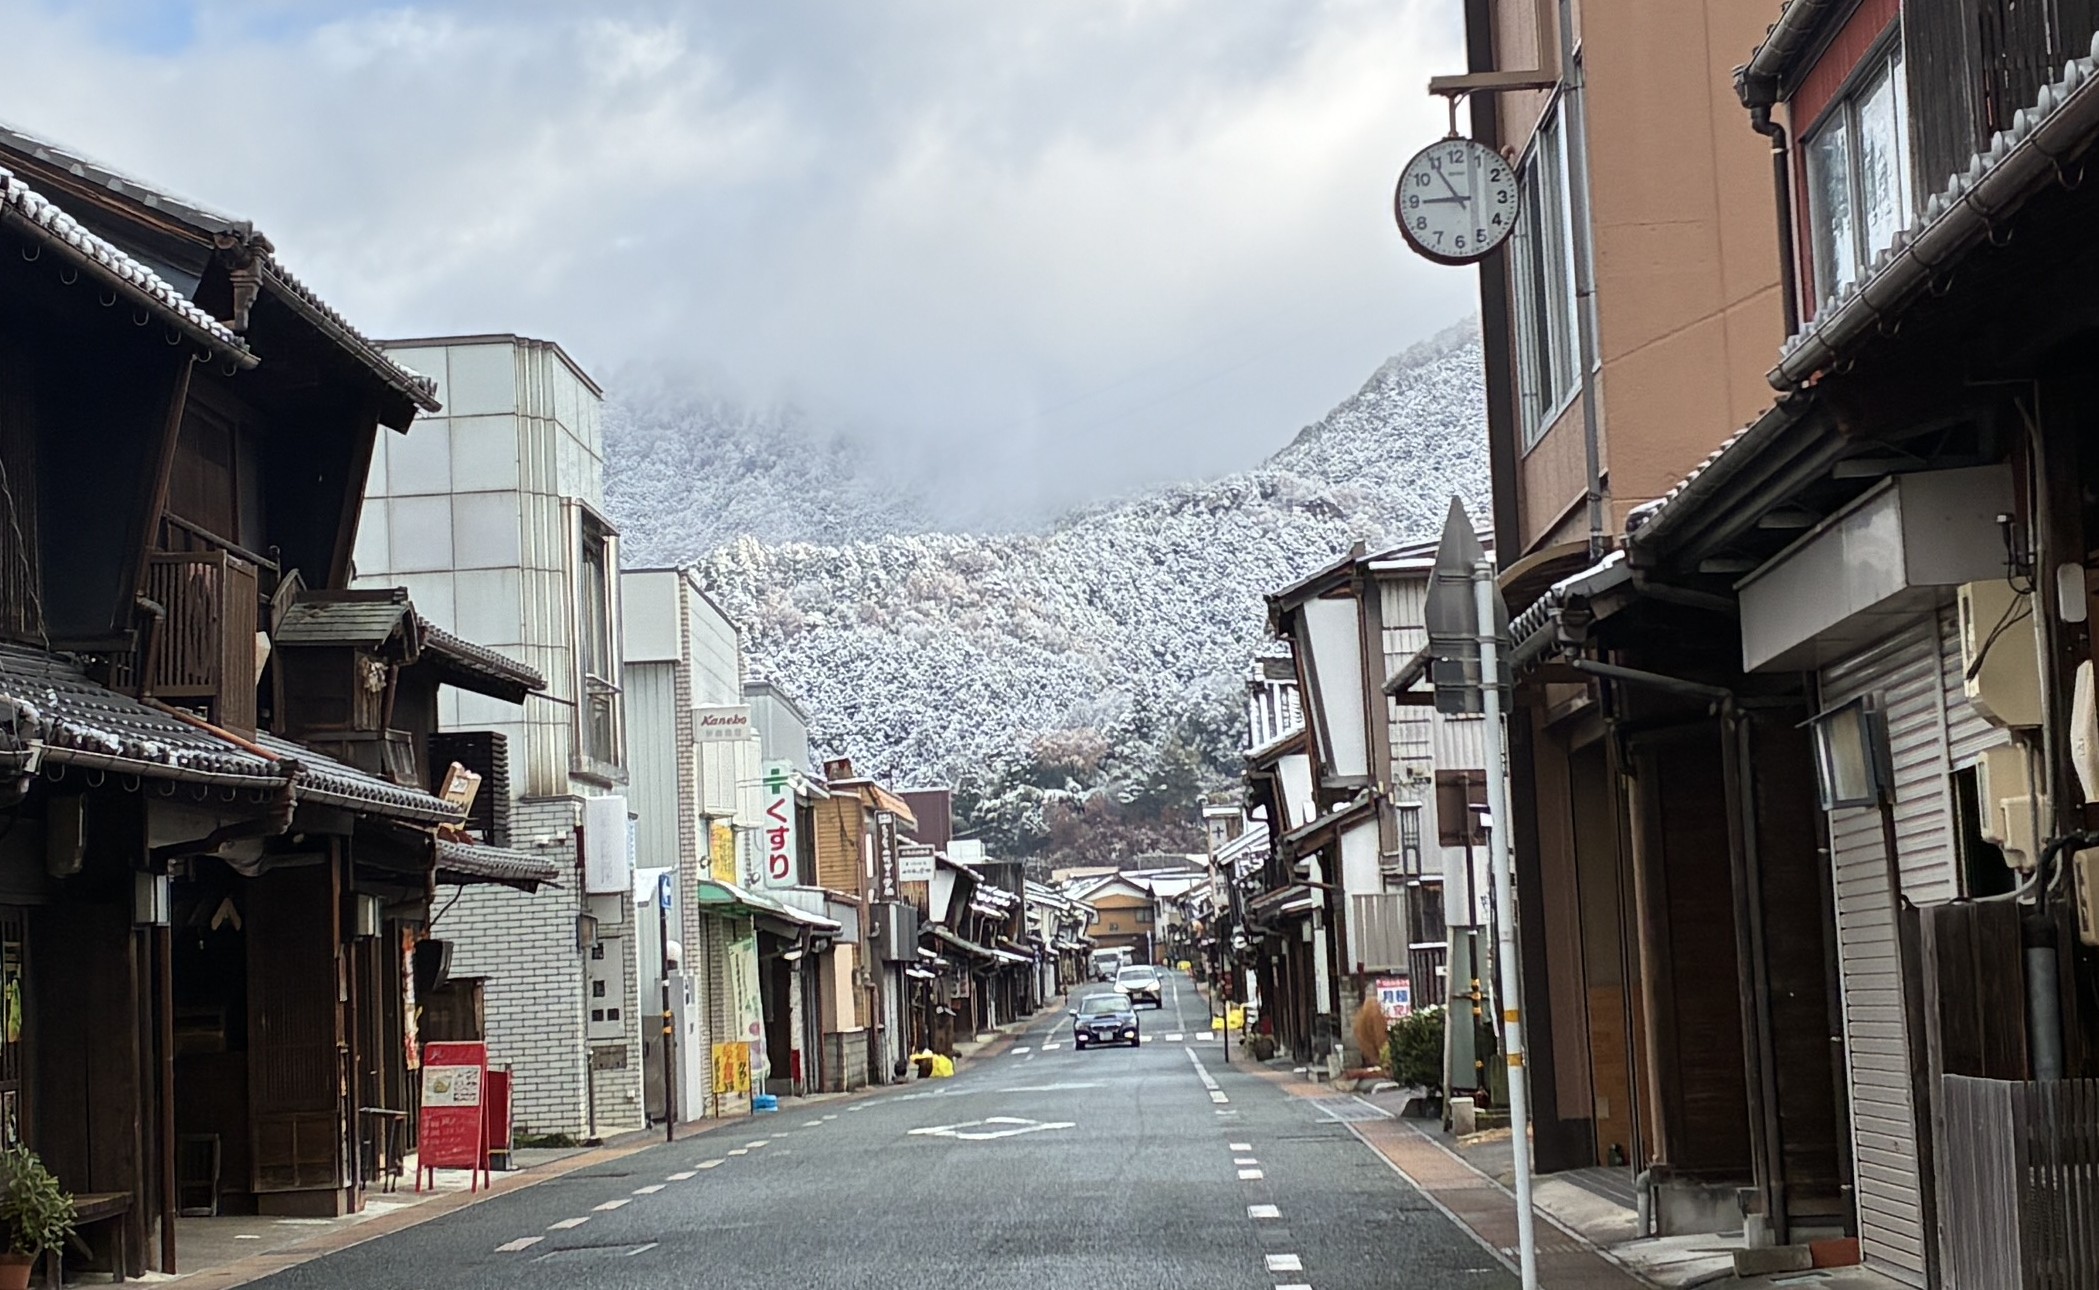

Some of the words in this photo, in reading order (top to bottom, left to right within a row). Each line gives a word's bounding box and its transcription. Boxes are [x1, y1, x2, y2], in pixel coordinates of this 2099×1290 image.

[1447, 149, 1464, 165] 12
[1474, 154, 1482, 168] 1
[1413, 172, 1431, 187] 10
[1490, 168, 1501, 183] 2
[1409, 194, 1420, 209] 9
[1496, 190, 1508, 204] 3
[1416, 216, 1428, 230] 8
[1491, 212, 1502, 226] 4
[1432, 231, 1443, 245] 7
[1454, 235, 1466, 249] 6
[1476, 229, 1487, 243] 5
[701, 713, 747, 726] Kanebo
[766, 797, 790, 880] くすり
